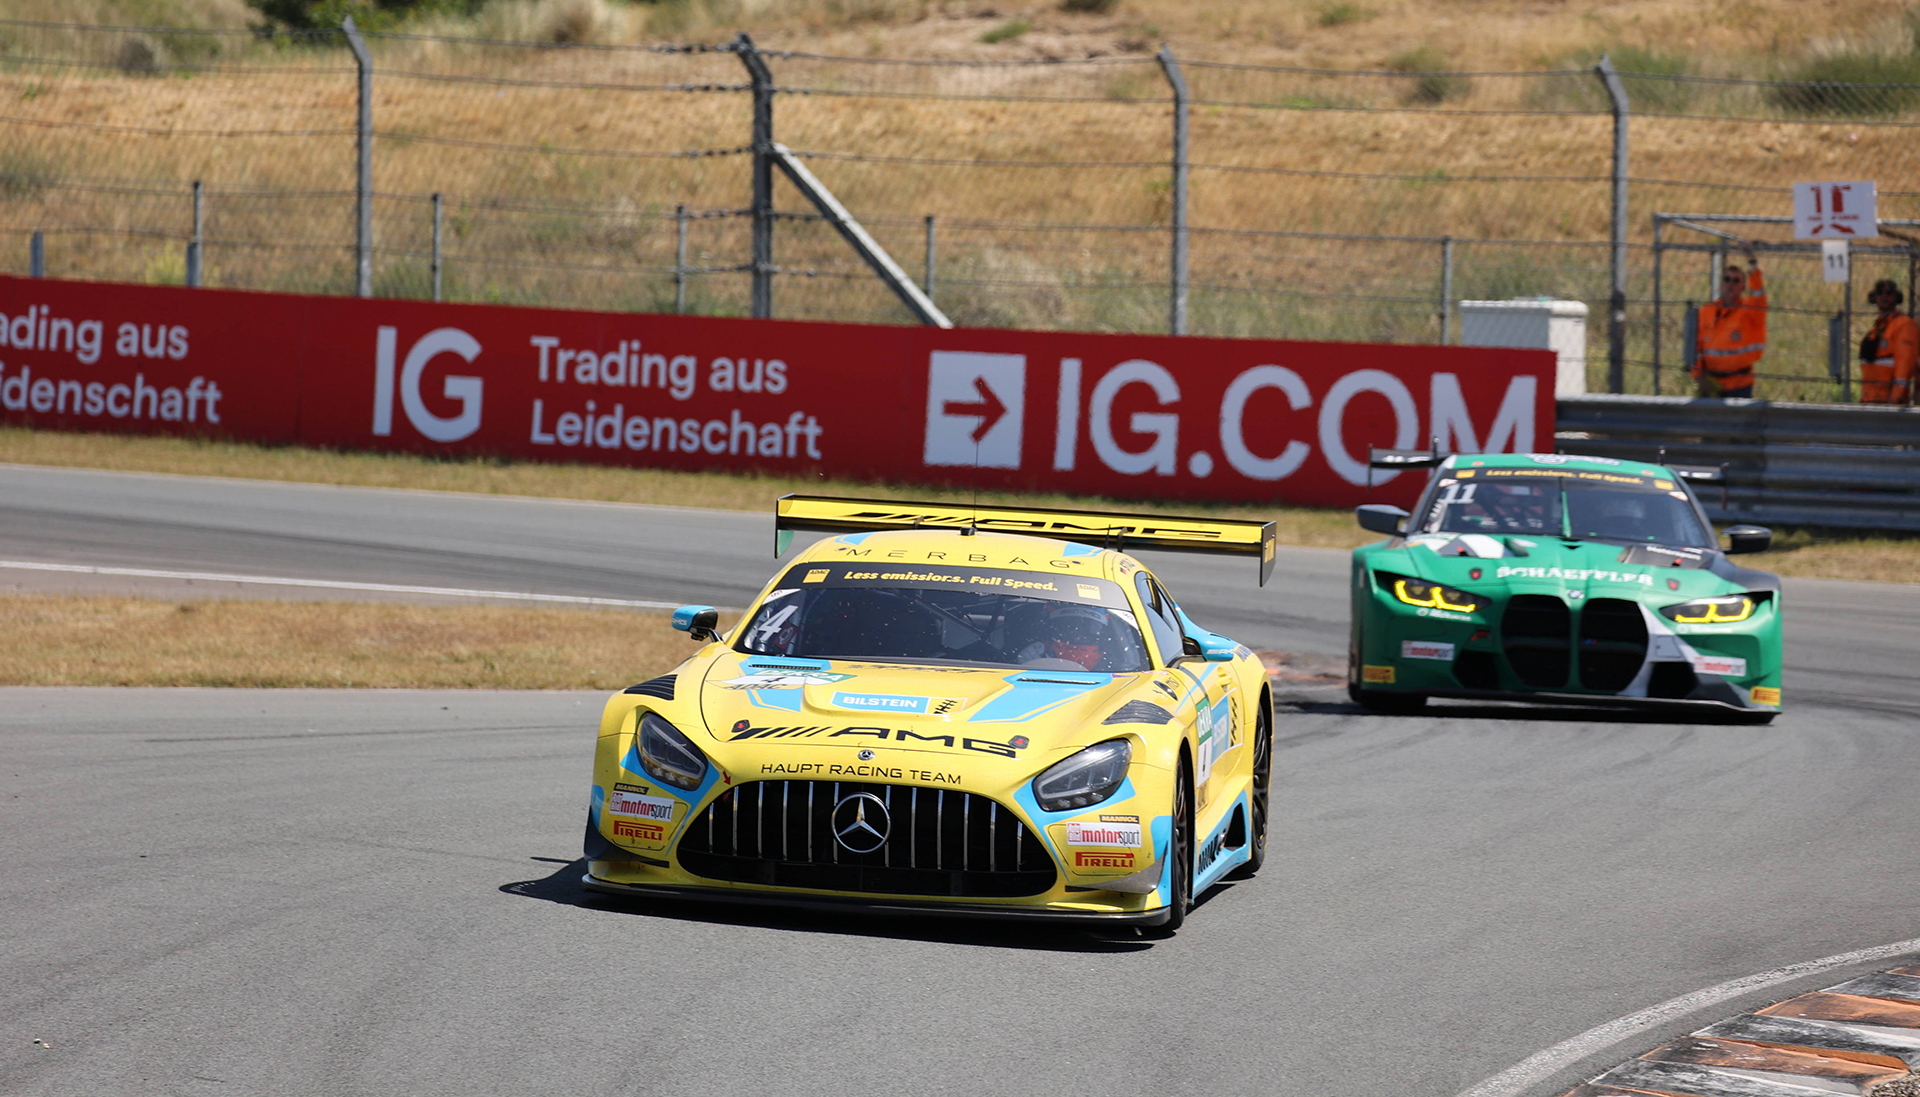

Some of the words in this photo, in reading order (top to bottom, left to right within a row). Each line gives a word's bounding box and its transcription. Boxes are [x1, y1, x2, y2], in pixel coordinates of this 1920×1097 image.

[1827, 253, 1844, 269] 11
[116, 322, 190, 360] aus
[530, 335, 697, 400] Trading
[708, 356, 788, 394] aus
[372, 326, 484, 442] IG
[530, 399, 823, 460] Leidenschaft
[1053, 358, 1538, 487] IG.COM
[1437, 483, 1478, 505] 11
[846, 549, 1070, 569] MERBAG
[844, 571, 878, 580] Less
[969, 576, 1002, 586] Full
[1003, 579, 1059, 592] Speed.
[1497, 566, 1653, 586] SCHAEFFLER
[758, 605, 798, 640] 4
[842, 696, 918, 709] BILSTEIN
[828, 727, 1017, 759] AMG
[761, 763, 823, 775] HAUPT
[829, 765, 903, 780] RACING
[911, 769, 962, 785] TEAM
[620, 800, 672, 819] motorsport
[613, 820, 664, 841] PIRELLI
[1081, 828, 1140, 846] motorsport
[1075, 852, 1134, 868] PIRELLI
